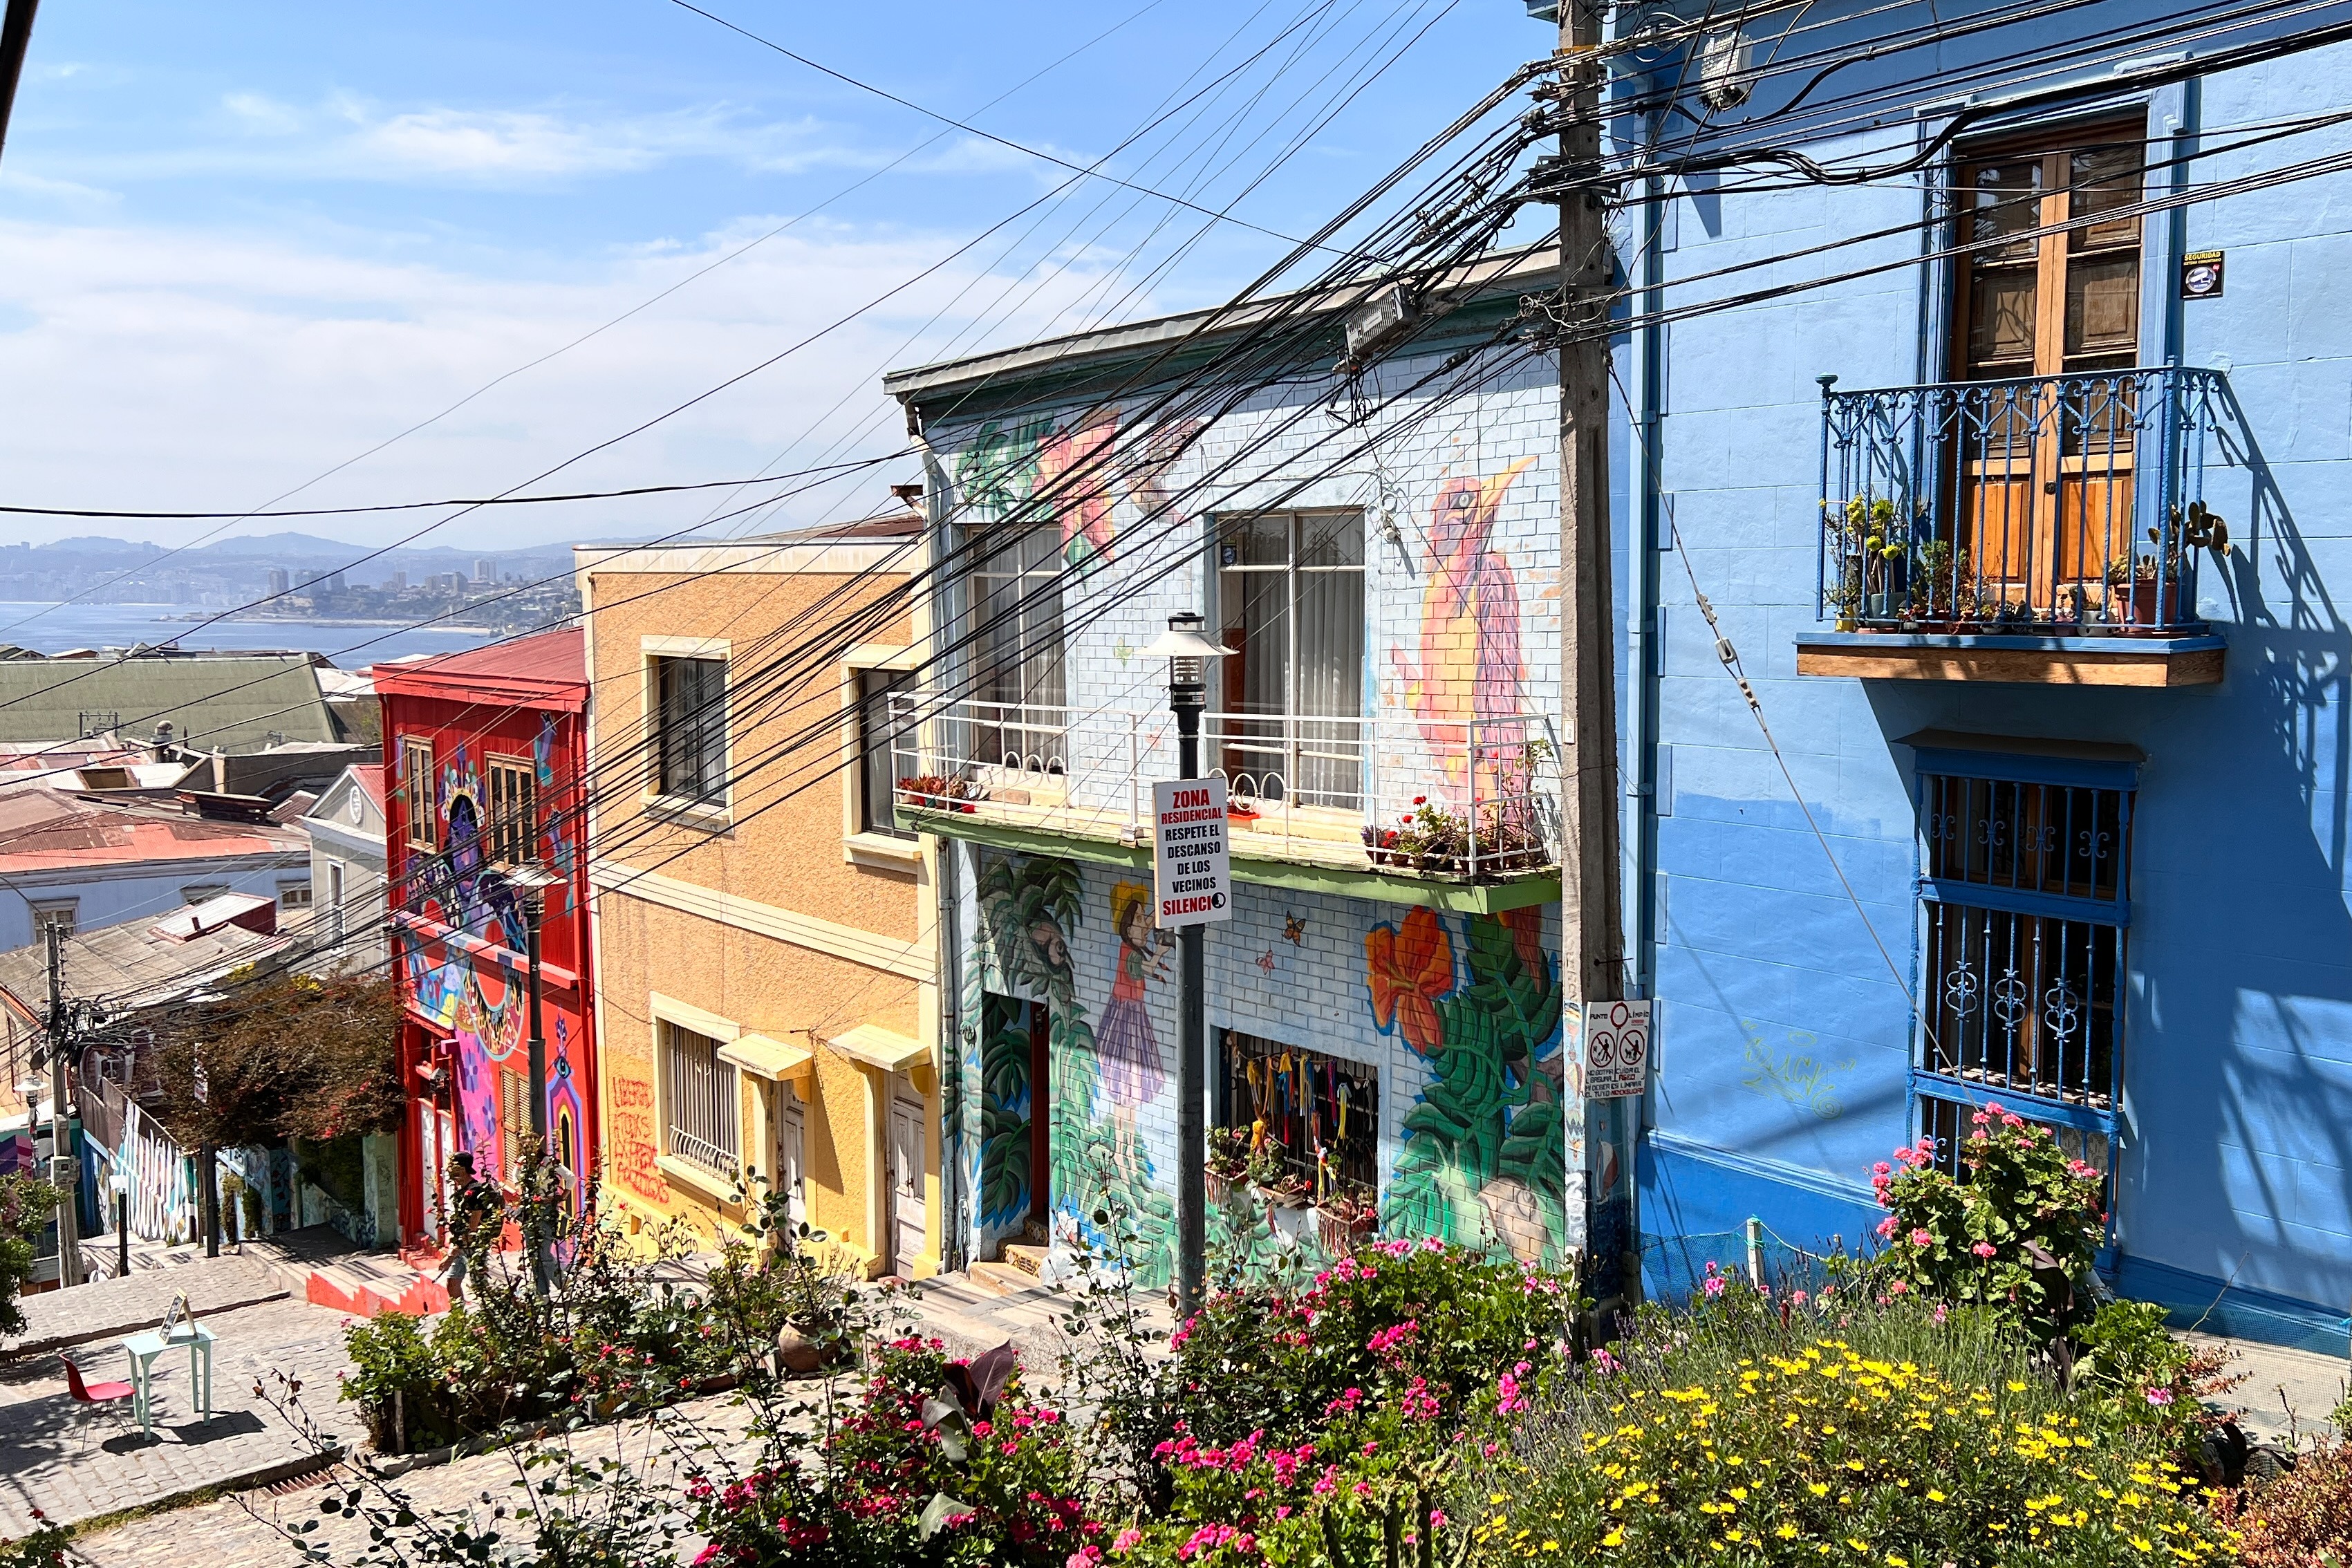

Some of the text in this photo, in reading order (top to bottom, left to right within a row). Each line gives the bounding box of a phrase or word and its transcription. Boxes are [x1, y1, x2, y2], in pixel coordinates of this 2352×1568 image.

[2185, 252, 2221, 261] SEGURIDAD
[1173, 789, 1210, 808] ZONA
[1161, 808, 1222, 825] RESIDENCIAL
[1165, 824, 1220, 841] RESPETE EL
[1167, 841, 1221, 859] DESCANSO
[1177, 860, 1211, 875] DE LOS
[1172, 877, 1216, 893] VECINOS
